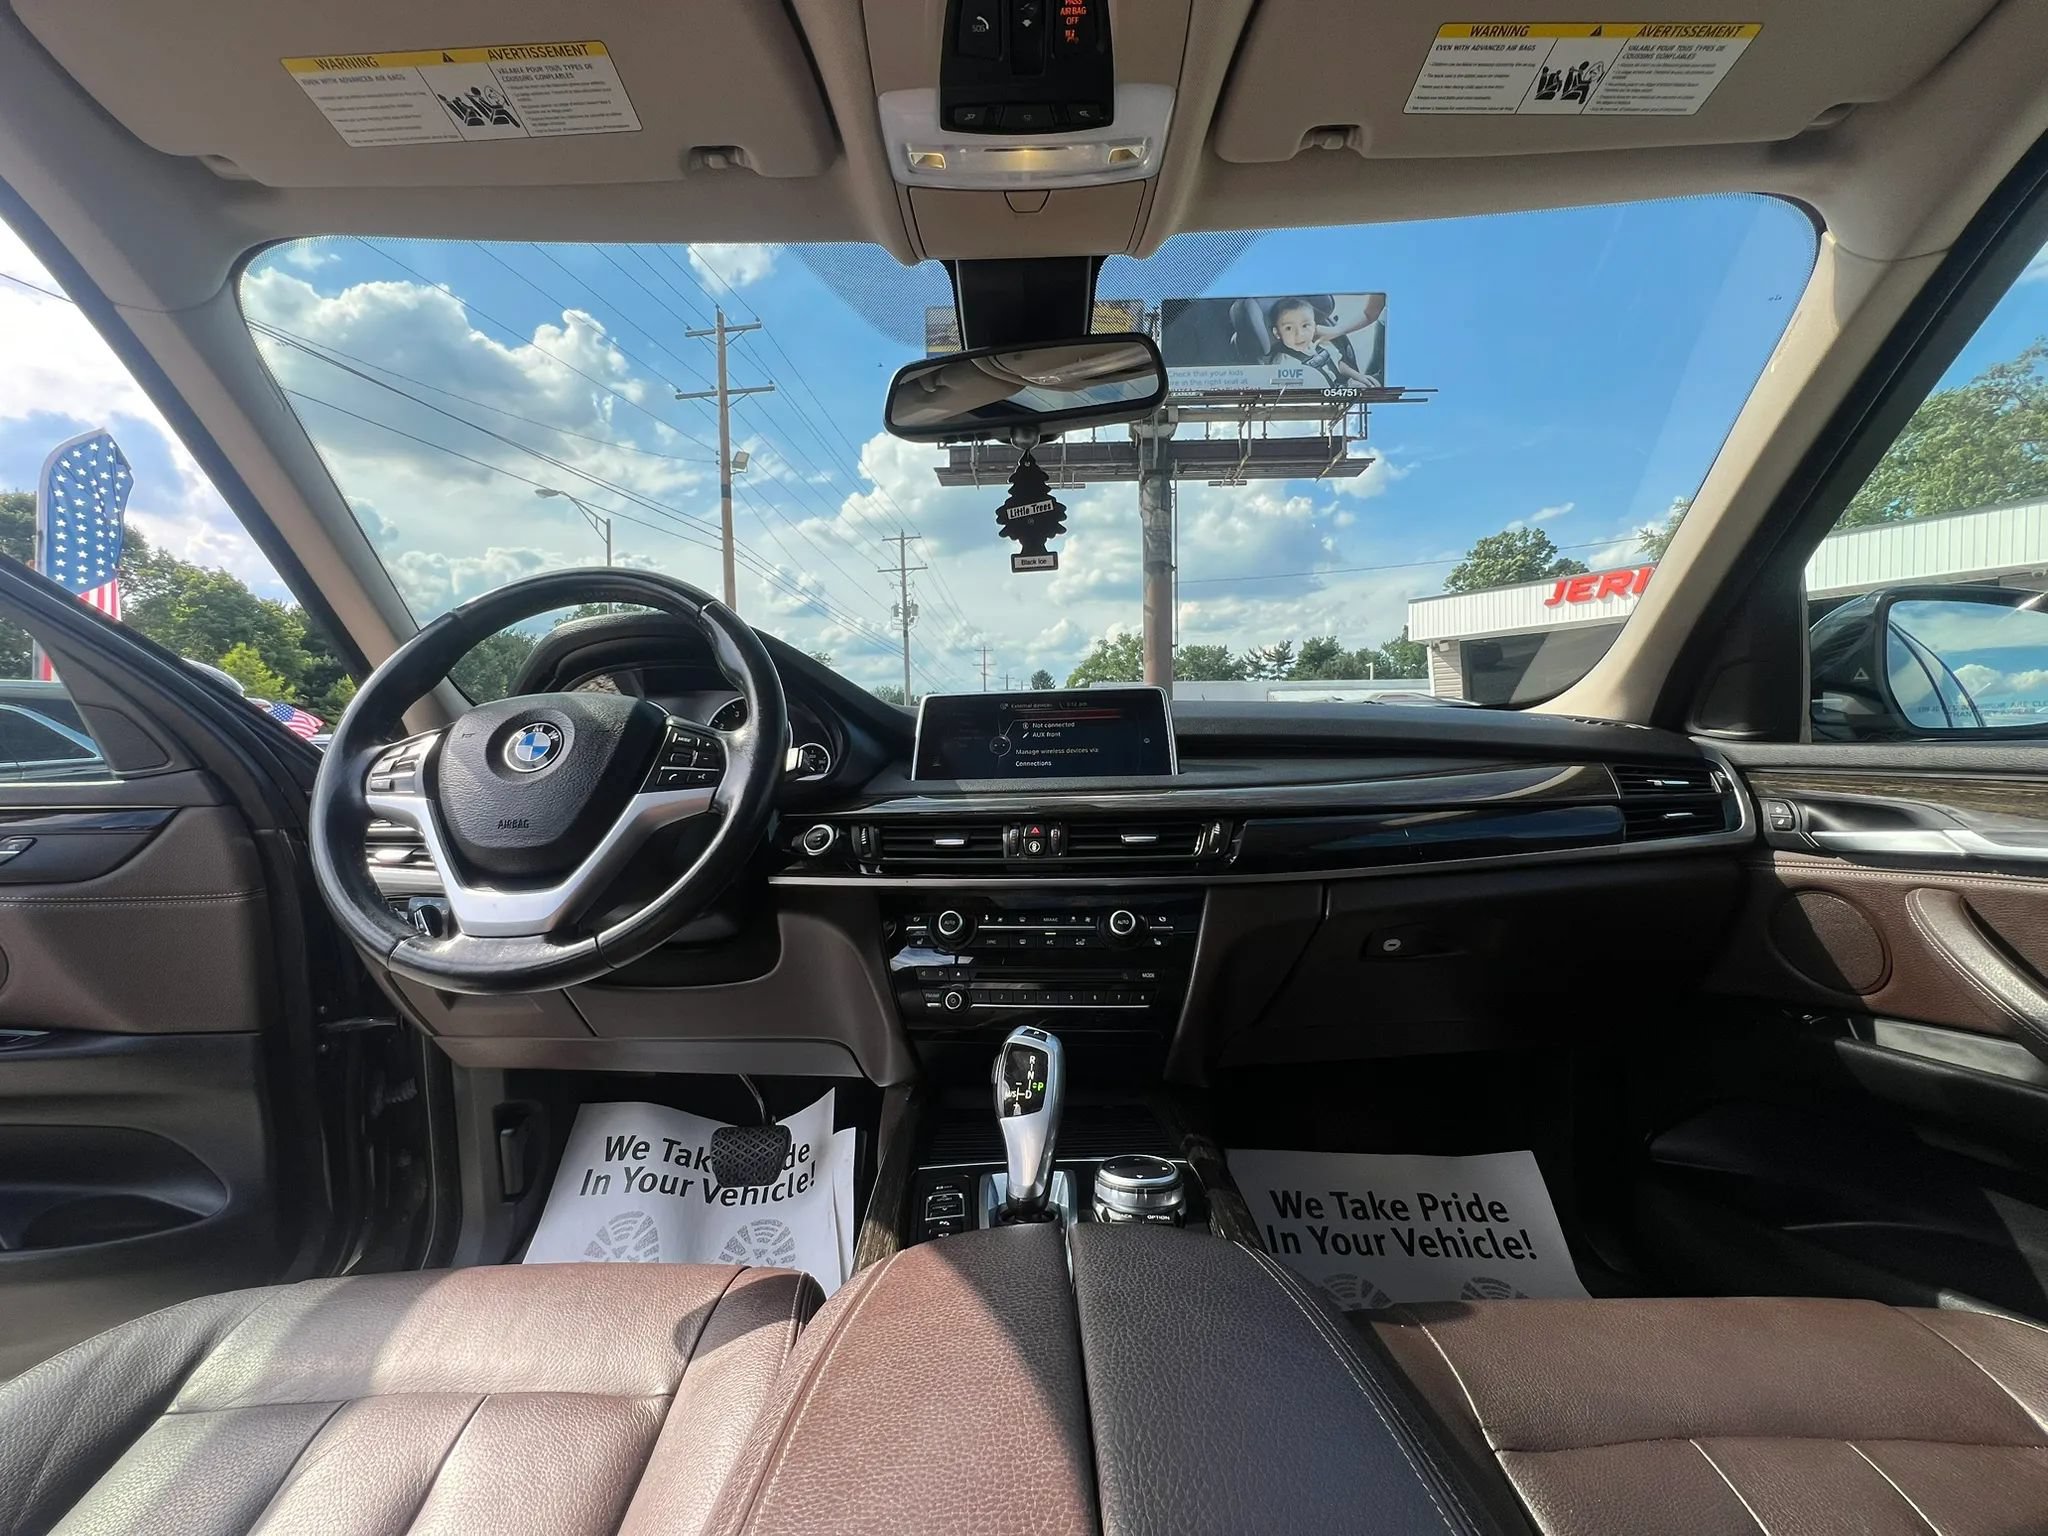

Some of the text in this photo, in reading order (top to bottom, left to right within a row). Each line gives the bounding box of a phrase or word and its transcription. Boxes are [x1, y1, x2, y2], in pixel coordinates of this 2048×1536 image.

[1060, 7, 1087, 15] AIR BAG
[1066, 17, 1080, 25] OFF
[1470, 25, 1531, 37] WARNING
[1636, 25, 1743, 37] AVERTISSEMENT
[487, 44, 589, 60] AVERTISSEMENT
[314, 56, 380, 70] WARNING
[1193, 369, 1208, 377] that
[1210, 370, 1227, 379] your
[1229, 369, 1244, 377] kids
[1323, 388, 1358, 397] 054751
[1010, 502, 1052, 518] Little Trees
[1044, 721, 1076, 729] connected
[513, 725, 560, 742] BMW
[1015, 748, 1040, 756] Manage
[498, 820, 530, 829] AIRBAG
[1029, 1055, 1036, 1064] R
[1027, 1070, 1035, 1080] N
[1037, 1081, 1044, 1091] P
[1024, 1090, 1032, 1099] D
[604, 1135, 712, 1173] We Tak
[580, 1160, 816, 1207] In Your Vehicle!
[1268, 1190, 1511, 1224] We Take Pride
[1266, 1225, 1538, 1260] In Your Vehicle!
